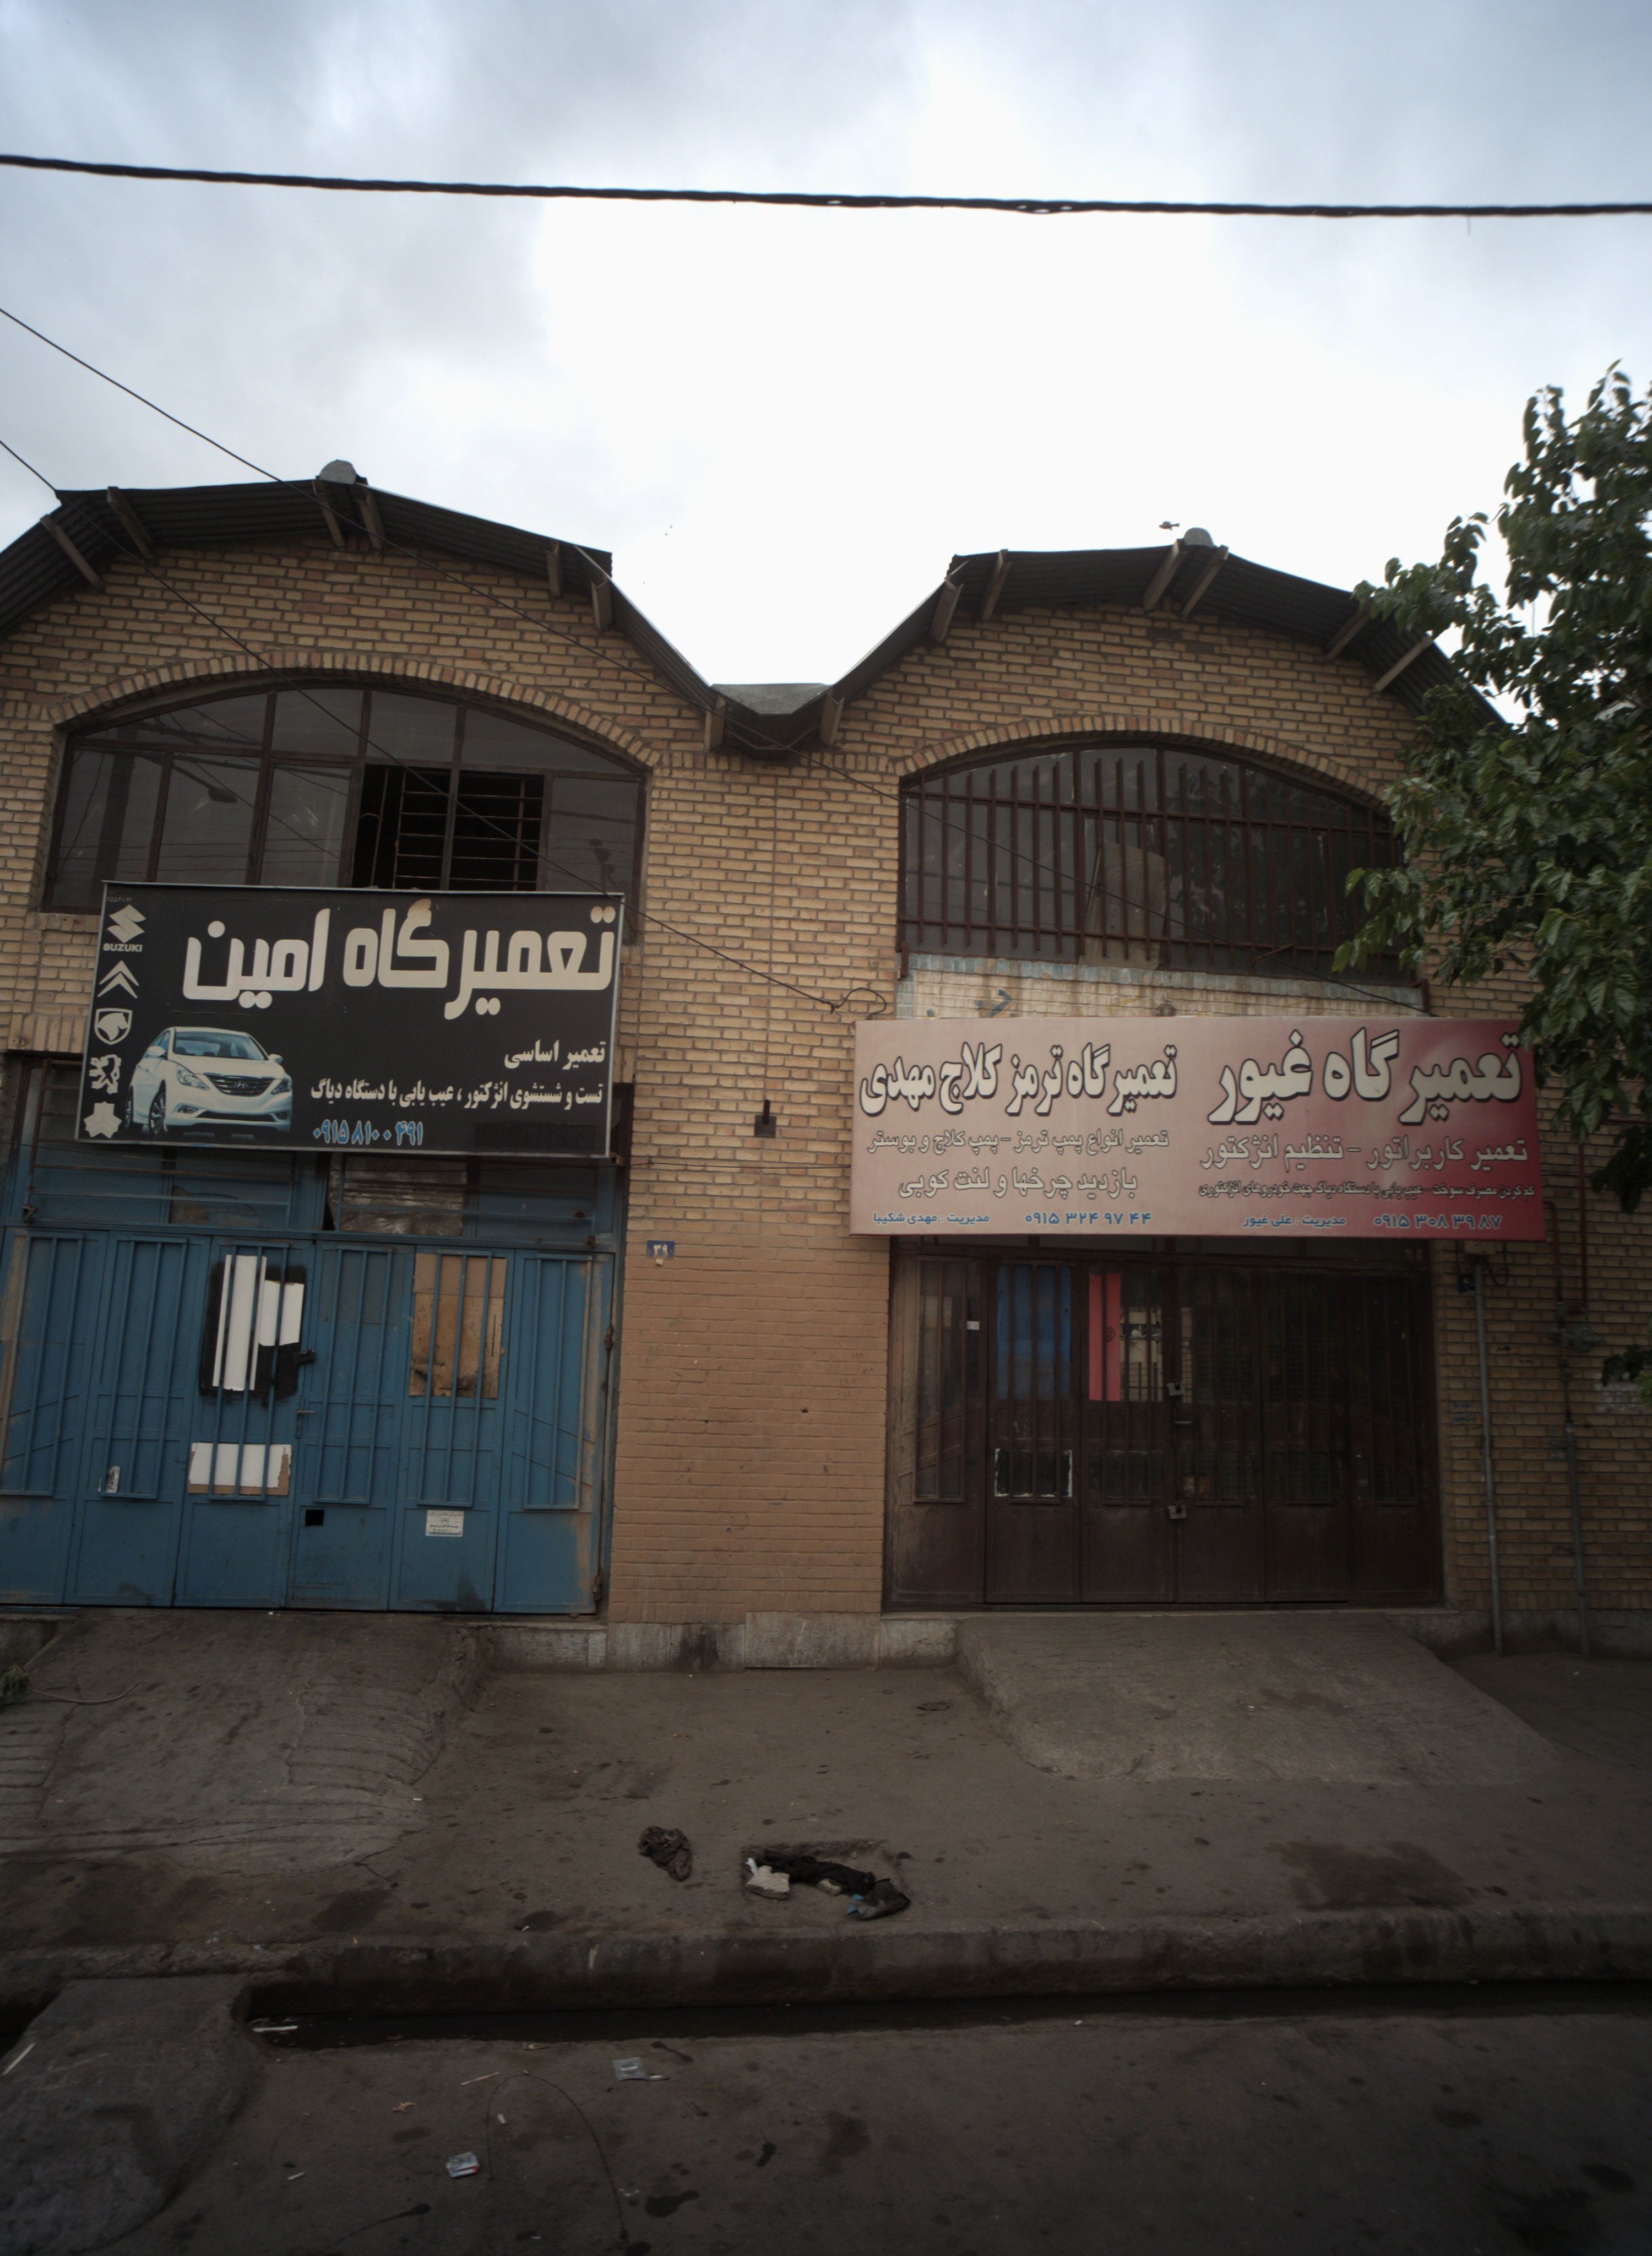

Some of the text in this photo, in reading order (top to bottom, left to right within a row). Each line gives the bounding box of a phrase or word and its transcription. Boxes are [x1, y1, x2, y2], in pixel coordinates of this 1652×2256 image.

[102, 943, 143, 952] SUZUKI
[183, 899, 616, 1020] تعمیرگاه امین
[504, 1039, 606, 1070] تعمیر اساسی
[860, 1056, 936, 1116] مهدی
[939, 1042, 1003, 1114] کلاج
[1005, 1044, 1064, 1116] ترمز
[1207, 1029, 1313, 1125] غیور
[311, 1078, 343, 1104] دیاگ
[345, 1078, 385, 1100] دستگاه
[388, 1079, 397, 1106] با
[399, 1080, 426, 1108] یابی
[428, 1086, 454, 1107] عیب
[510, 1082, 562, 1109] شستشوی
[564, 1091, 573, 1110] و
[575, 1083, 604, 1104] تست
[867, 1130, 917, 1154] بوستر
[918, 1135, 931, 1153] و
[933, 1129, 965, 1155] کلاج
[1013, 1129, 1050, 1153] ترمز
[1052, 1135, 1083, 1156] پمپ
[1086, 1128, 1123, 1156] انواع
[1125, 1129, 1170, 1154] تعمیر
[1200, 1133, 1279, 1170] انژکتور
[1366, 1134, 1465, 1170] کاربراتور
[1469, 1138, 1528, 1172] تعمیر
[898, 1166, 1138, 1200] بازدید چرخها و لنت کوبی
[1199, 1180, 1242, 1198] انژکتوری
[1292, 1183, 1313, 1198] جهت
[1338, 1180, 1371, 1195] دستگاه
[1371, 1181, 1381, 1199] با
[1432, 1182, 1465, 1200] سوخت
[1465, 1182, 1497, 1200] مصرف
[873, 1212, 905, 1225] شکیبا
[907, 1214, 937, 1225] مهدی
[947, 1212, 990, 1225] مدیریت
[1242, 1213, 1269, 1228] غیور
[1270, 1214, 1292, 1227] علی
[1301, 1214, 1347, 1228] مدیریت
